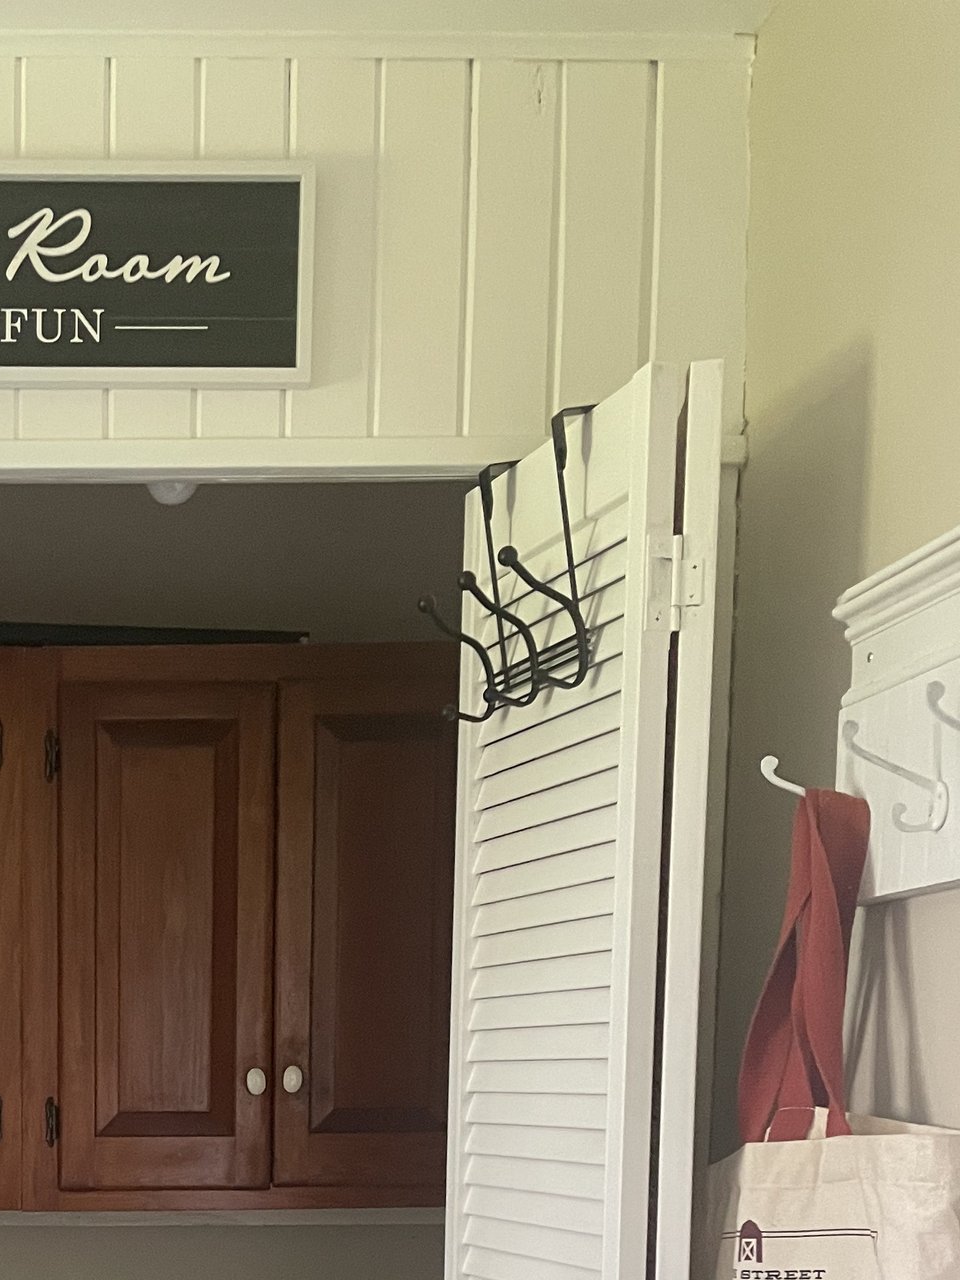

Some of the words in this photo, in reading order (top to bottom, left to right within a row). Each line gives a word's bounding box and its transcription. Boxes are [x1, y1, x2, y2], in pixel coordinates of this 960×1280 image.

[6, 207, 231, 285] Room
[0, 308, 105, 344] FUN
[740, 1269, 826, 1280] STREET
